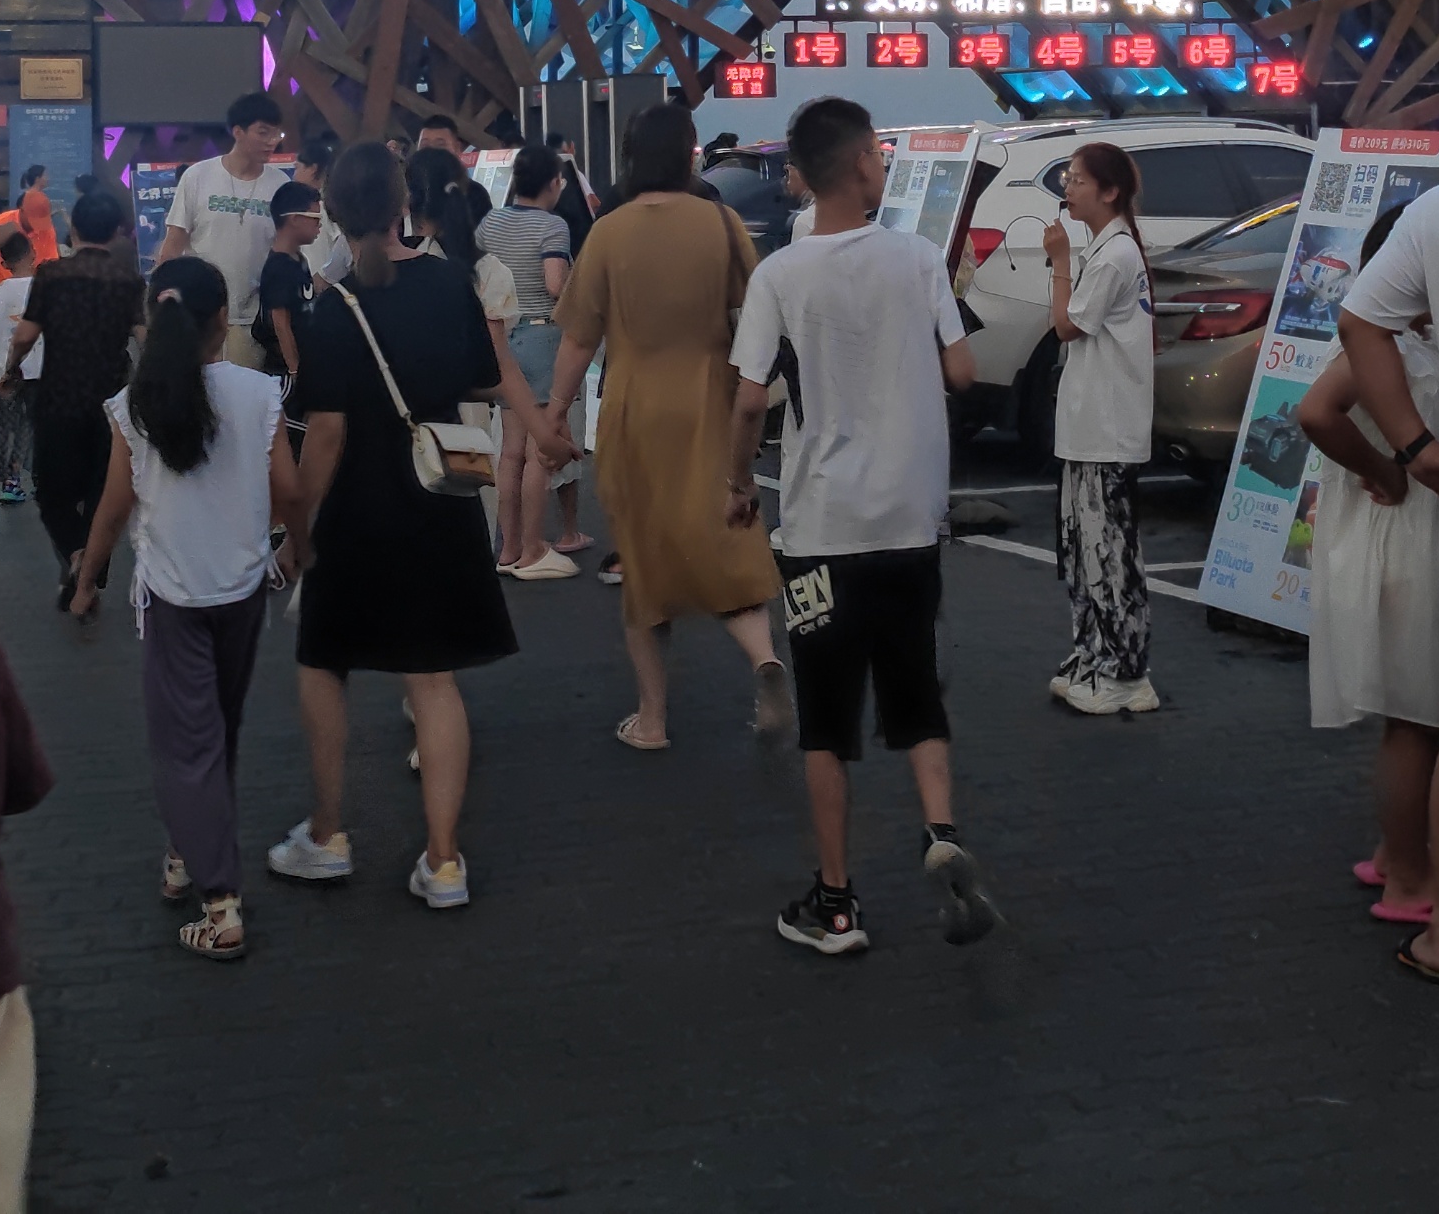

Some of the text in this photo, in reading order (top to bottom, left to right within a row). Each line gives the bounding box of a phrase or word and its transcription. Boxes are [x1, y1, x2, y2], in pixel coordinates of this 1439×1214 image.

[795, 35, 840, 64] 1号
[878, 35, 922, 65] 2号
[961, 36, 1004, 65] 3号
[1037, 36, 1083, 65] 4号
[1114, 37, 1156, 65] 5号
[1189, 37, 1230, 65] 6号
[1254, 64, 1298, 94] 7号
[1354, 163, 1379, 184] 扫码
[1348, 185, 1375, 205] 购票
[1265, 341, 1296, 370] 50
[1227, 492, 1255, 522] 30
[1213, 548, 1255, 574] Biluota
[1209, 566, 1238, 590] Park
[1271, 569, 1300, 601] 20
